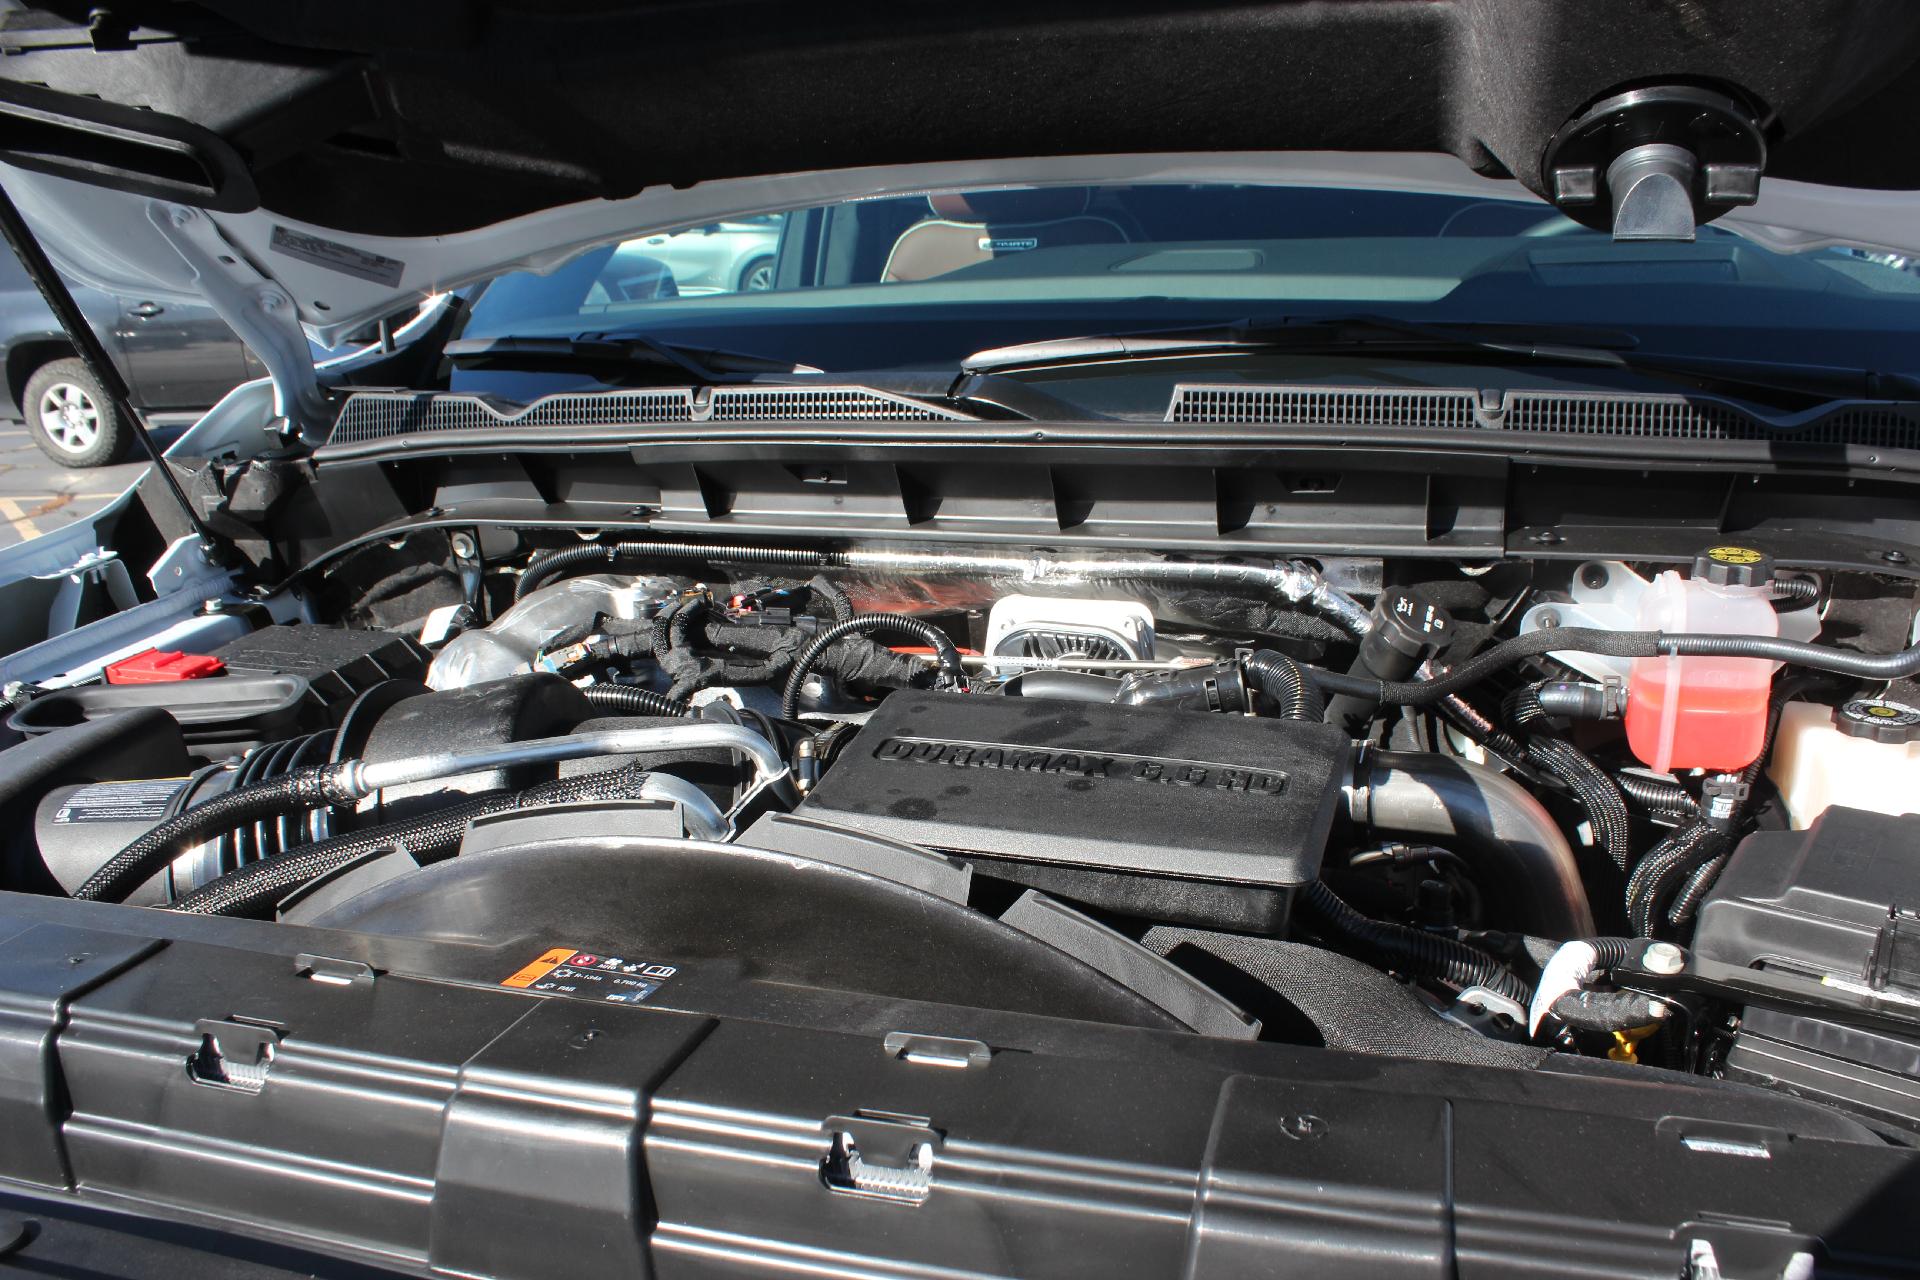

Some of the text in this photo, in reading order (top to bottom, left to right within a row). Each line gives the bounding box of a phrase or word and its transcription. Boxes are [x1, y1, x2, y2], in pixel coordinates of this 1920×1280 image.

[879, 741, 1285, 795] DURAMAX 6.6 HD
